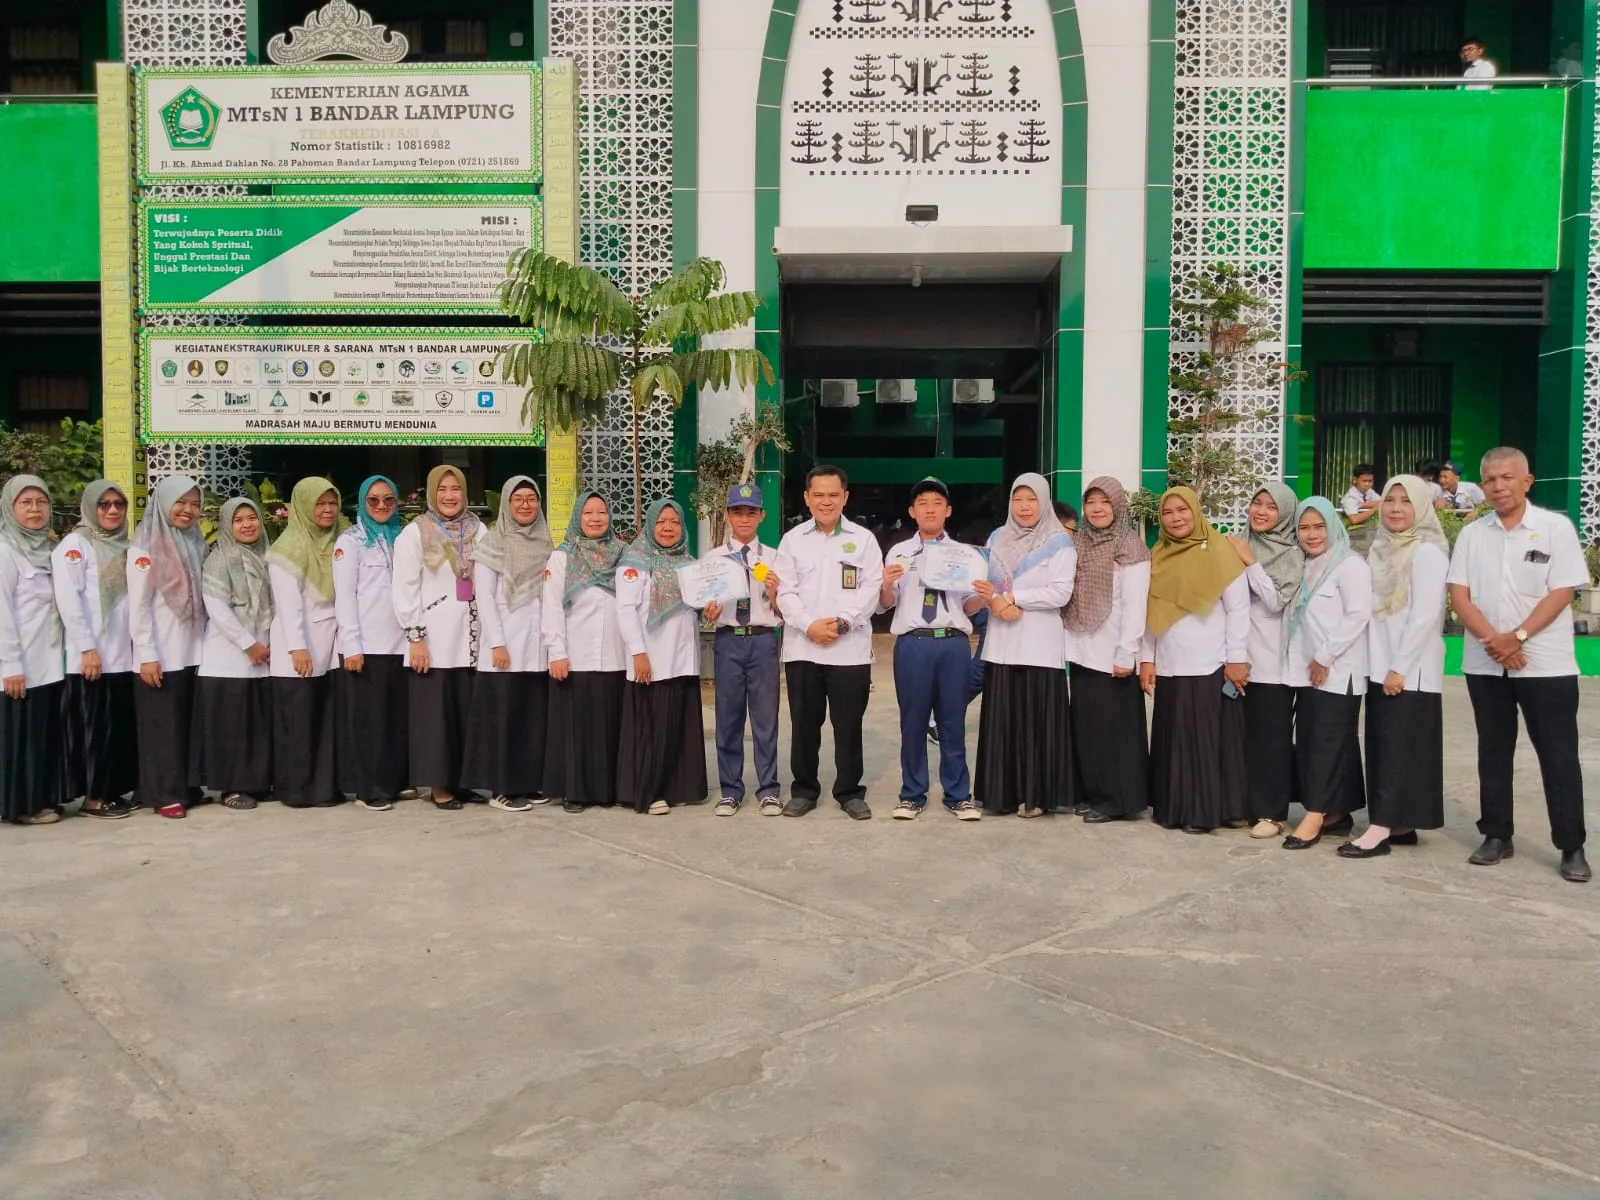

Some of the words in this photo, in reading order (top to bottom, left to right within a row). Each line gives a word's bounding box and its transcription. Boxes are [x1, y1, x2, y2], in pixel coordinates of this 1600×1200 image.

[270, 85, 400, 100] KEMENTERIAN
[404, 84, 470, 97] AGAMA
[227, 106, 288, 122] MTsN
[295, 107, 302, 121] 1
[310, 105, 400, 121] BANDAR
[404, 104, 515, 120] LAMPUNG
[299, 127, 420, 140] TERAKREDITASI
[290, 142, 331, 152] Nomor
[335, 141, 384, 151] Statistik
[397, 140, 451, 150] 10816982
[190, 160, 223, 168] Ahmad
[225, 158, 258, 168] Dahlan
[260, 159, 276, 168] No.
[277, 159, 289, 167] 28
[291, 159, 334, 168] Pahoman
[336, 158, 370, 167] Bandar
[372, 158, 417, 168] Lampung
[418, 157, 456, 167] Telepon
[457, 157, 486, 167] (0721)
[487, 157, 520, 166] 251869
[154, 214, 180, 223] VISI
[481, 216, 509, 225] MISI
[153, 229, 215, 239] Terwujudnya
[217, 229, 254, 238] Peserta
[256, 228, 283, 237] Didik
[153, 241, 176, 251] Yang
[179, 241, 210, 250] Kokoh
[211, 241, 253, 251] Spritual,
[153, 253, 187, 262] Unggul
[189, 252, 229, 261] Prestasi
[231, 252, 251, 261] Dan
[154, 264, 179, 274] Bijak
[181, 264, 244, 274] Berteknologi
[324, 344, 331, 353] &
[334, 344, 374, 353] SARANA
[379, 344, 405, 353] MTsN
[409, 344, 413, 353] 1
[417, 344, 457, 353] BANDAR
[245, 420, 300, 429] MADRASAH
[303, 420, 330, 429] MAJU
[333, 420, 382, 429] BERMUTU
[384, 420, 437, 429] MENDUNIA
